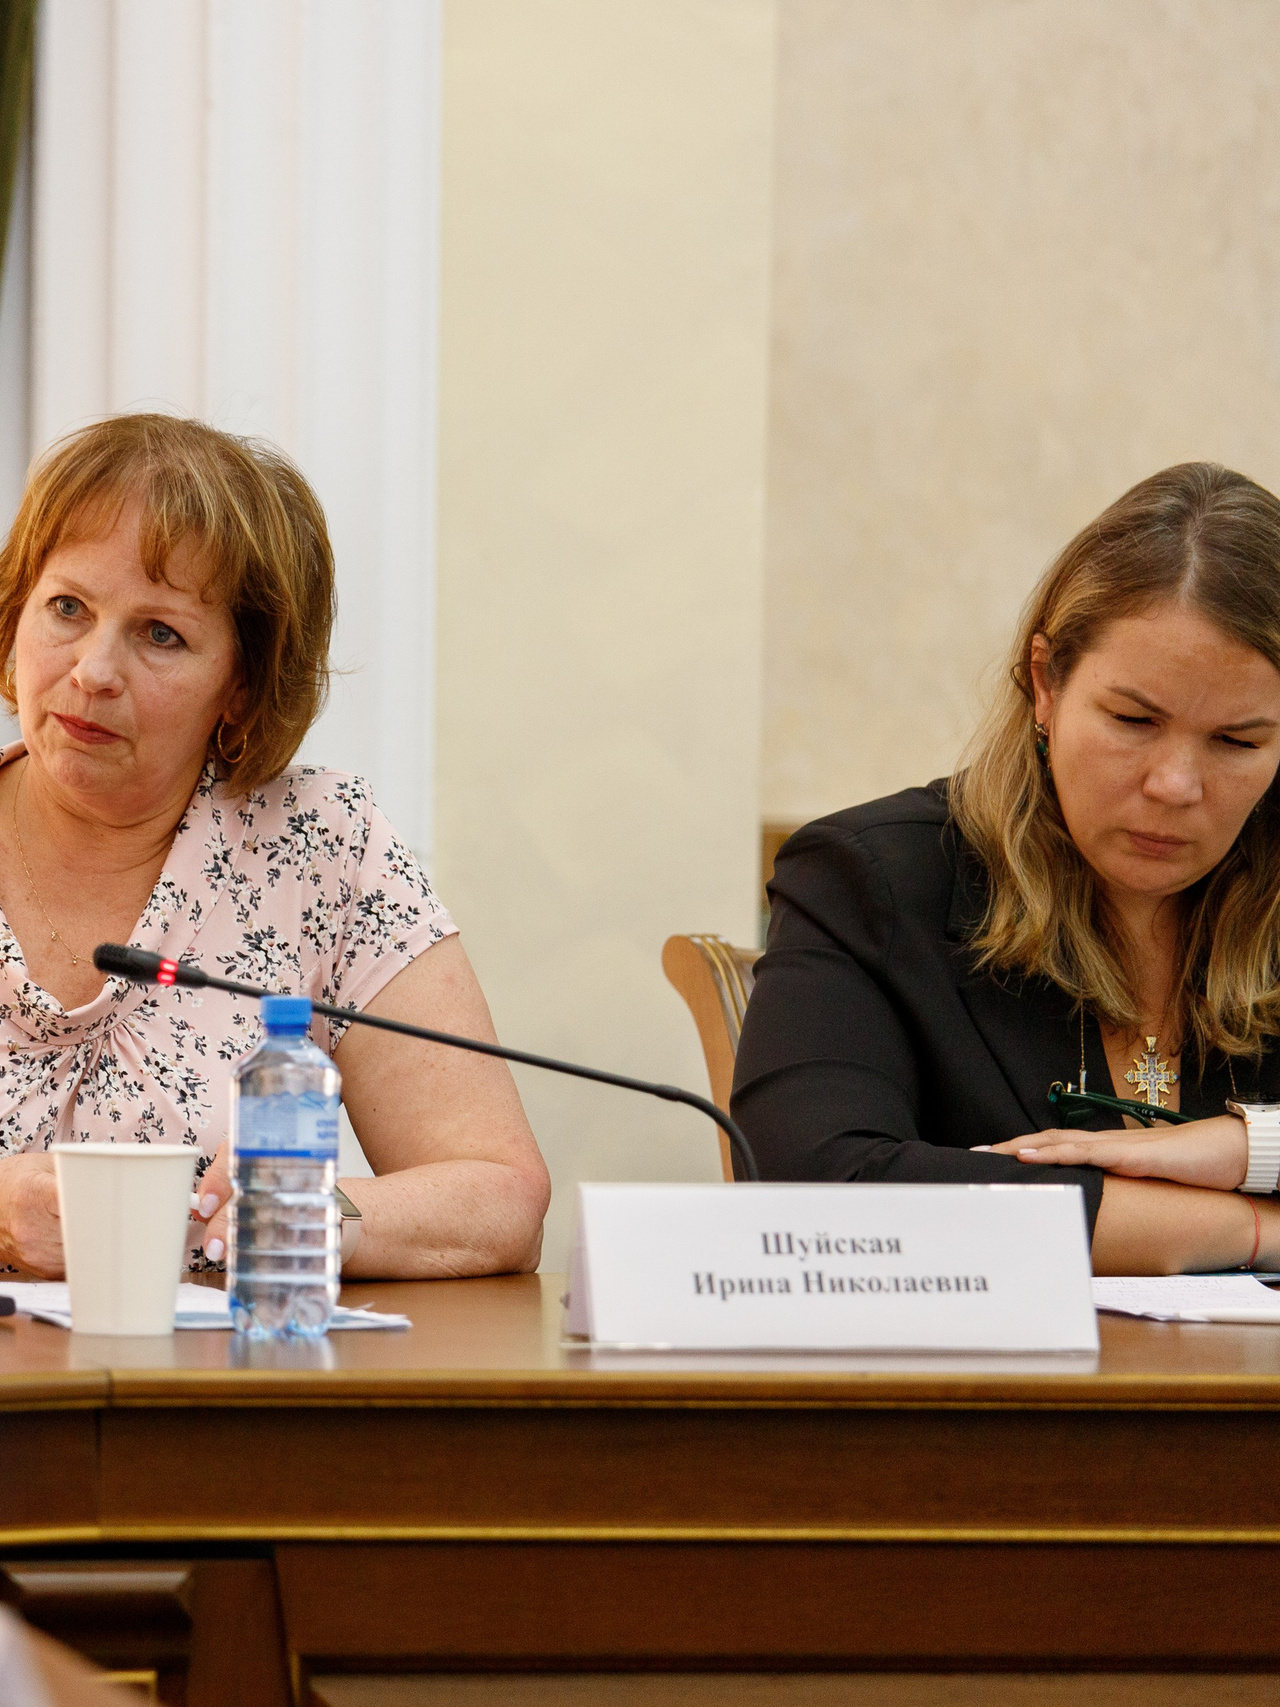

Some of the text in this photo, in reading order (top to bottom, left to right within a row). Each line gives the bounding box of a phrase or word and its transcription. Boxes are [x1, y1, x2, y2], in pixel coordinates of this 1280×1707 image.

[761, 1231, 902, 1261] Шуйская
[693, 1270, 989, 1301] Ирина Николаевна
